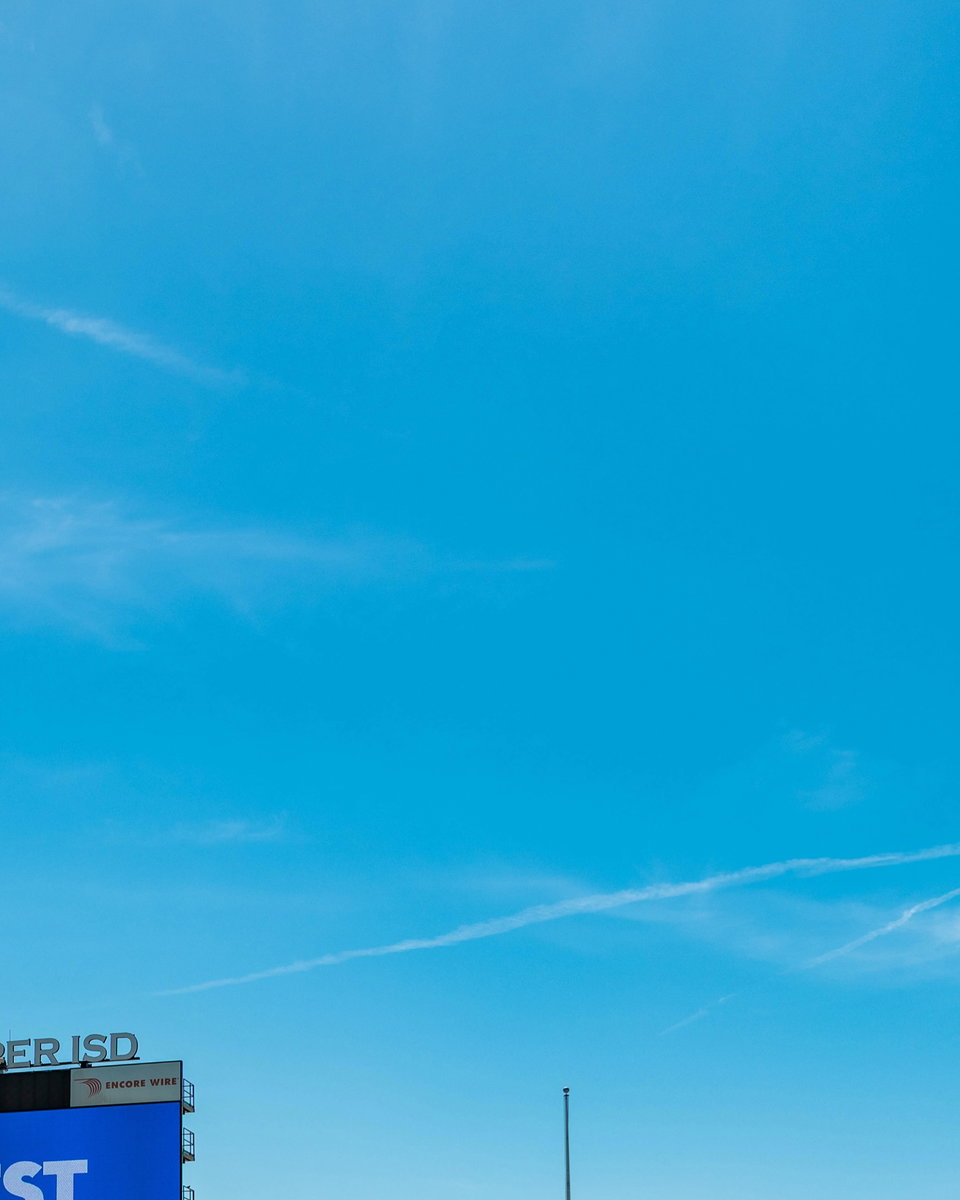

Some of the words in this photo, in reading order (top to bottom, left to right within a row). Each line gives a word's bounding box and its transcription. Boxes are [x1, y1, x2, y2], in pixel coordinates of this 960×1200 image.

[71, 1032, 139, 1063] ISD
[105, 1079, 146, 1089] ENCORE
[149, 1077, 177, 1086] WIRE
